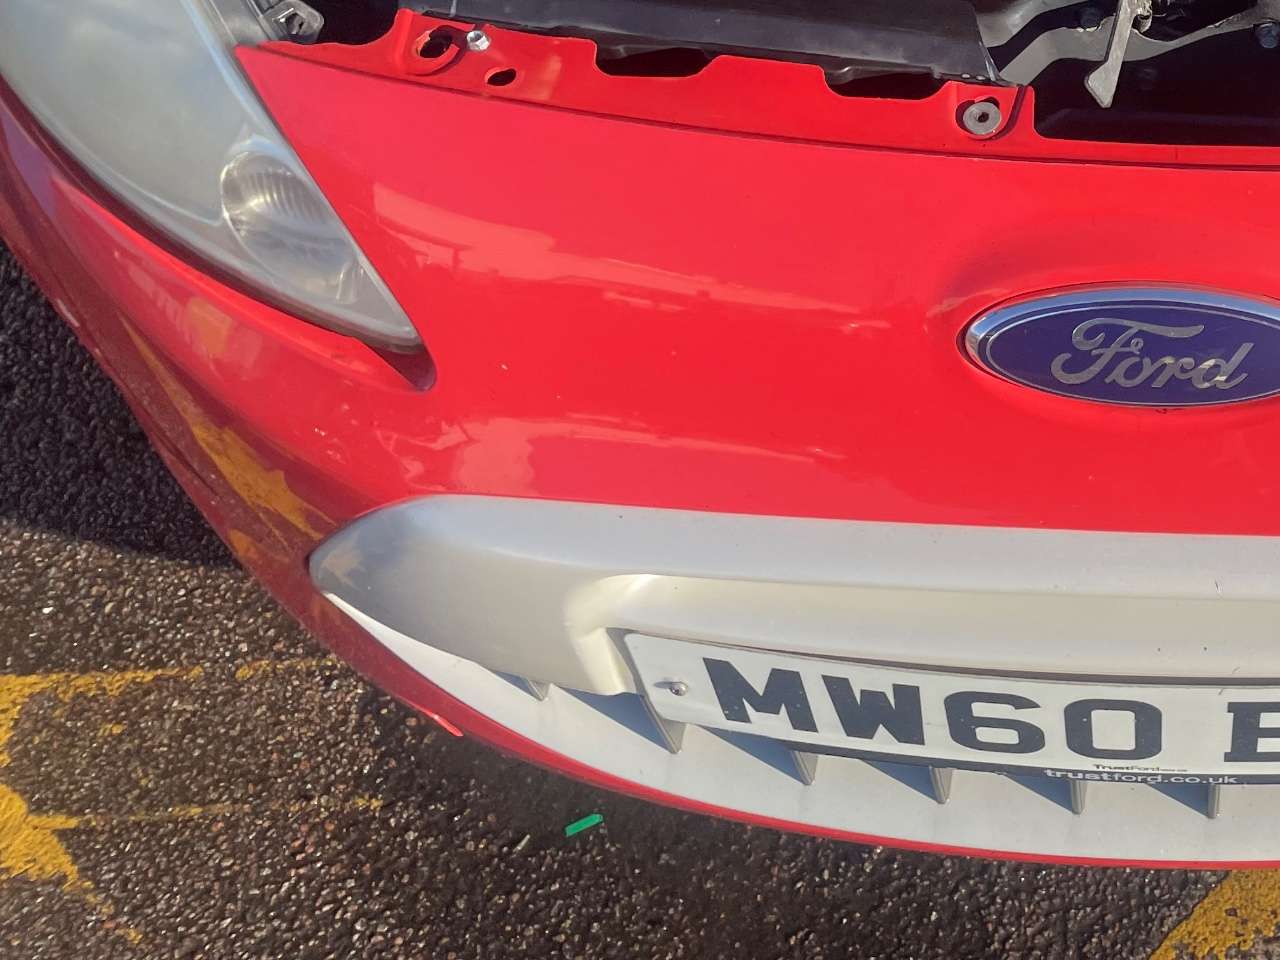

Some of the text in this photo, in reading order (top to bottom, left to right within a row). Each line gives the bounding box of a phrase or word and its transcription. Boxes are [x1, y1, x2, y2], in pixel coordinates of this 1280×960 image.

[1050, 317, 1254, 389] Ford
[701, 656, 1163, 759] MW60
[1043, 769, 1238, 784] trustford.co.uk
